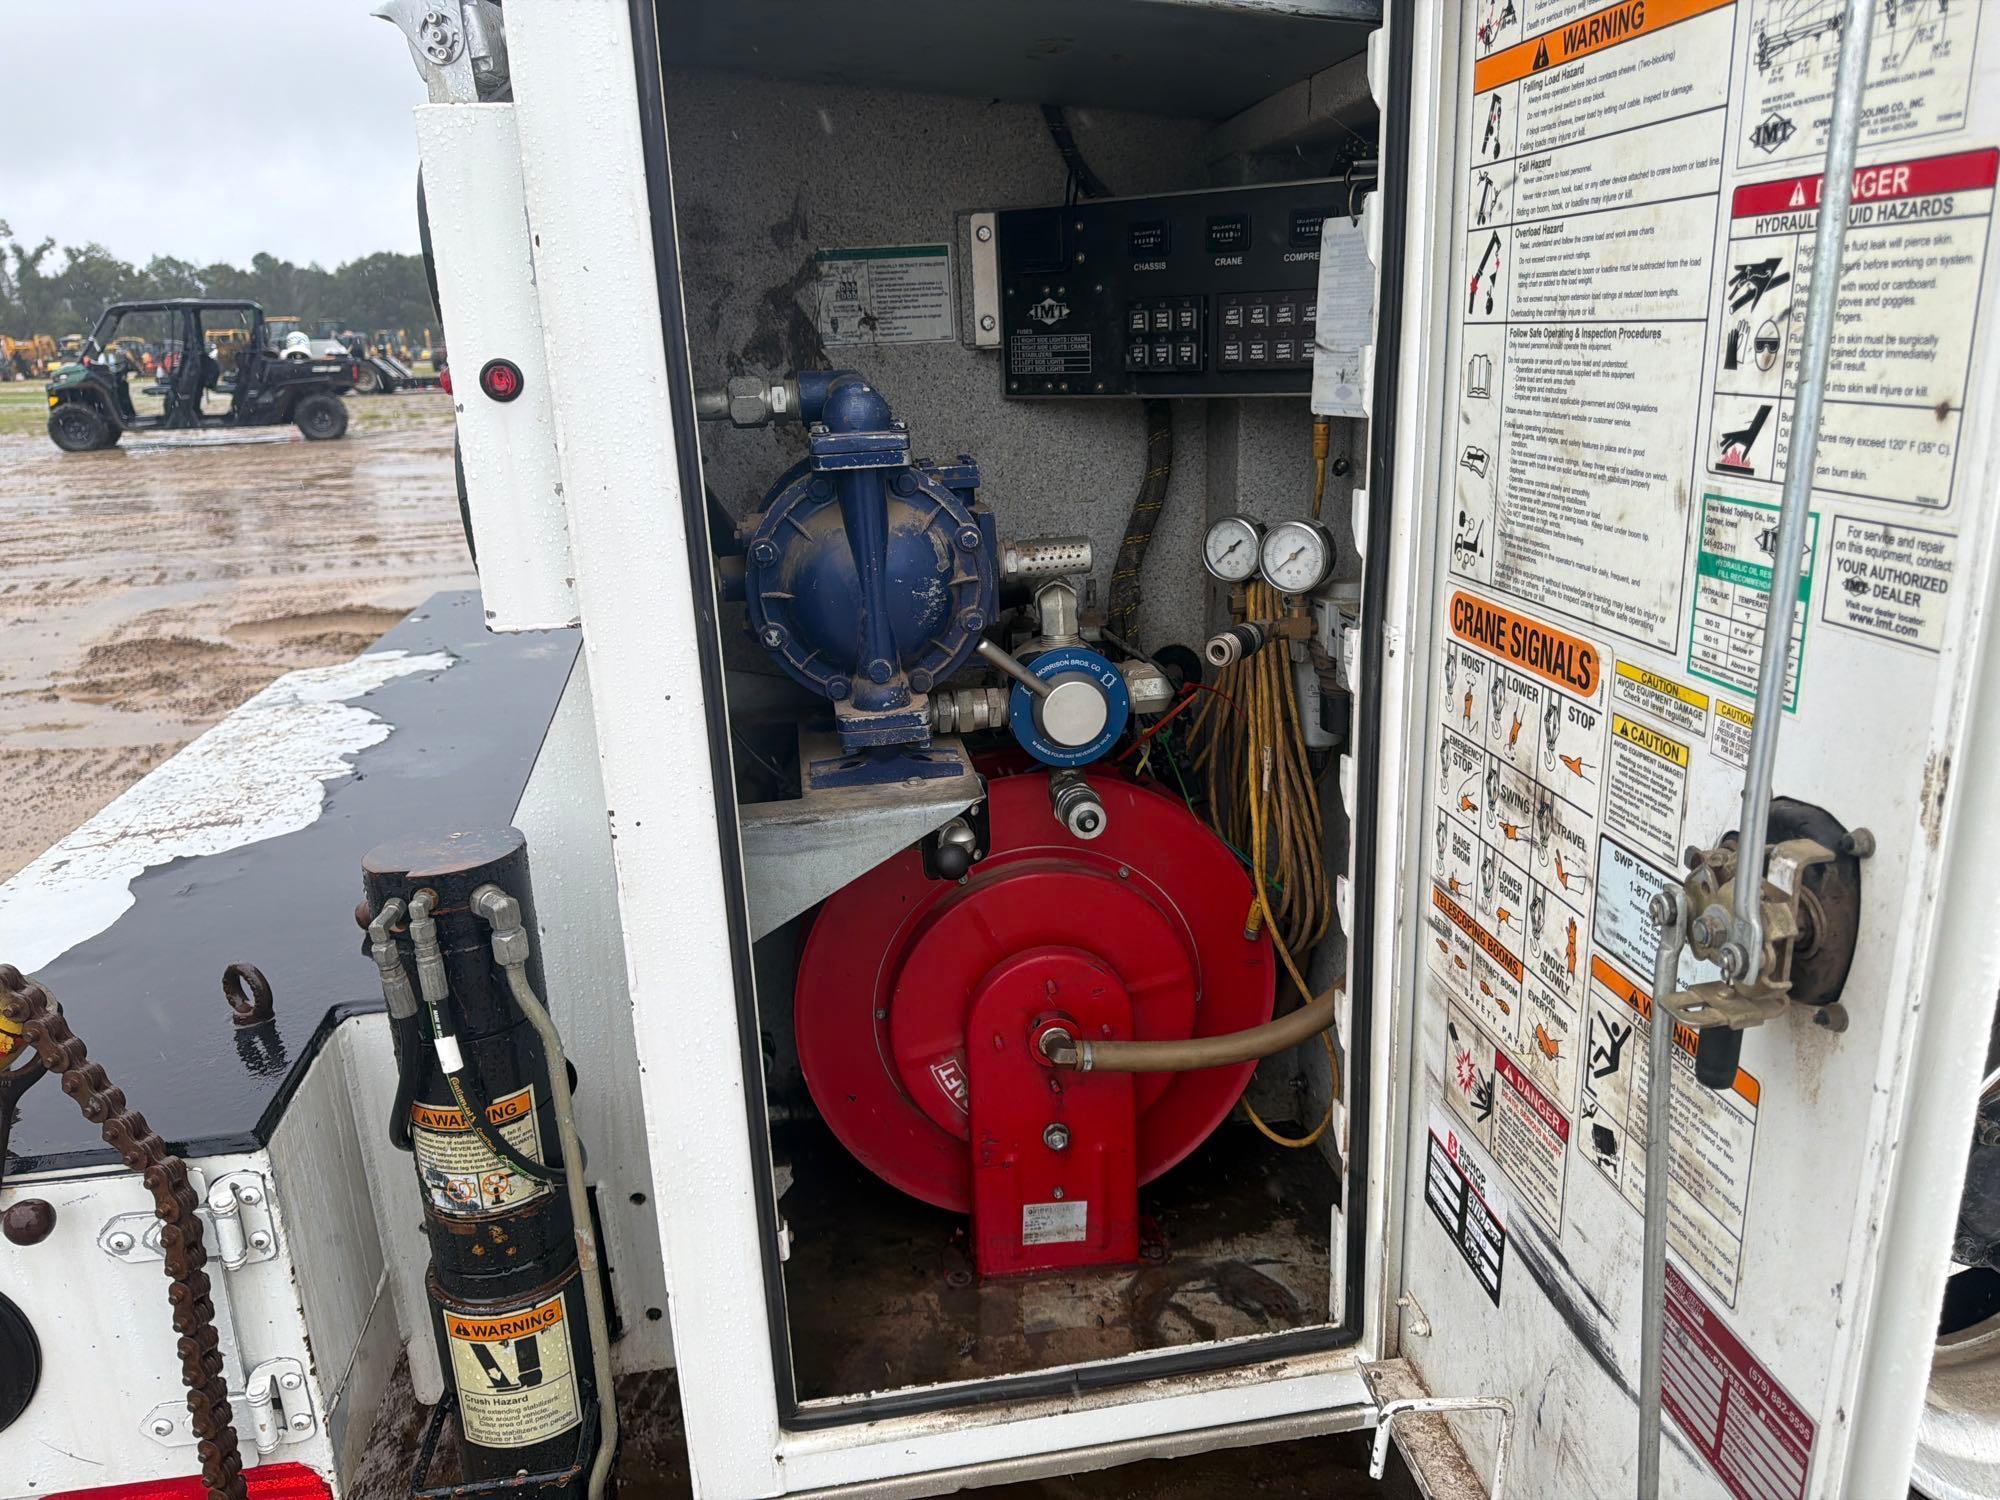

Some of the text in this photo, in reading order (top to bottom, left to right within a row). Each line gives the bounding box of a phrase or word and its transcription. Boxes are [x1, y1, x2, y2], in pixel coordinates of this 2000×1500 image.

[1563, 1, 1644, 55] WARNING
[1523, 63, 1584, 94] Falling Load Hazard
[1754, 119, 1791, 147] IMT
[1519, 156, 1551, 172] Fall Hazard
[1851, 206, 1873, 224] UID
[1878, 196, 1954, 221] HAZARDS
[1515, 224, 1563, 238] Overload Hazard
[1852, 241, 1868, 250] fluid
[1870, 240, 1887, 250] leak
[1888, 238, 1902, 247] will
[1905, 236, 1930, 249] pierce
[1134, 262, 1166, 271] CHASSIS
[1215, 257, 1243, 266] CRANE
[1863, 253, 1973, 270] before working on system.
[1841, 278, 1937, 292] with wood or cardboard.
[1032, 303, 1065, 319] IMT
[1838, 296, 1916, 308] gloves and goggles.
[1510, 328, 1661, 340] Follow Safe Operating & Inspection Procedures
[1847, 335, 1861, 344] skin
[1864, 335, 1883, 344] must
[1886, 335, 1896, 344] be
[1898, 335, 1938, 347] surgically
[1839, 436, 1854, 447] may
[1857, 437, 1886, 448] exceed
[1909, 441, 1915, 451] F
[1707, 503, 1718, 513] Iowa
[1720, 506, 1732, 516] Mold
[1734, 508, 1750, 521] Tooling
[1766, 513, 1776, 524] Inc.
[1724, 519, 1737, 529] Iowa
[1705, 527, 1715, 536] USA
[1848, 526, 1944, 554] For service and repair
[1836, 540, 1847, 550] on
[1848, 541, 1862, 553] this
[1864, 546, 1914, 565] equipment,
[1837, 558, 1947, 593] YOUR AUTHORIZED
[1701, 586, 1729, 600] HYDRAULIC
[1845, 580, 1921, 607] IMT DEALER
[1846, 600, 1859, 611] Visit
[1861, 605, 1873, 614] our
[1875, 607, 1895, 620] dealer
[1850, 613, 1918, 637] www.imt.com
[1454, 598, 1591, 690] CRANE SIGNALS
[1036, 660, 1069, 678] MORRISON
[1071, 659, 1089, 667] BROS.
[1462, 653, 1485, 675] HOIST
[1507, 673, 1539, 703] LOWER
[1641, 674, 1678, 696] CAUTION
[1617, 679, 1703, 720] AVOID EQUIPMENT DAMAGE
[1623, 690, 1640, 704] Check
[1650, 702, 1663, 715] level
[1666, 708, 1693, 729] regularly.
[1568, 706, 1595, 730] STOP
[1450, 735, 1483, 764] EMERGENCY
[1614, 740, 1628, 752] AVOID
[1628, 746, 1656, 766] EQUIPMENT
[1631, 727, 1679, 761] CAUTION
[1453, 753, 1473, 773] STOP
[1501, 784, 1529, 814] SWING
[1453, 832, 1471, 853] RAISE
[1557, 823, 1587, 851] TRAVEL
[1452, 845, 1470, 866] BOOM
[1498, 868, 1522, 894] LOWER
[1614, 850, 1664, 890] SWP Techni
[1499, 882, 1520, 906] BOOM
[1436, 891, 1519, 974] TELESCOPING BOOMS
[1455, 934, 1470, 952] BOOM
[1543, 951, 1565, 974] MOVE
[1475, 954, 1518, 998] RETRACT BOOM
[1540, 967, 1570, 995] SLOWLY
[1528, 989, 1568, 1033] EVERYTHING
[1541, 990, 1556, 1009] DOG
[1518, 1076, 1559, 1130] DANGER
[1460, 1145, 1486, 1185] BISHOP
[1458, 1157, 1485, 1199] LIFTING
[472, 1309, 555, 1337] WARNING
[1749, 1366, 1769, 1396] (575)
[465, 1395, 528, 1406] Crush Hazard
[467, 1405, 485, 1414] Before
[487, 1406, 521, 1415] extending
[471, 1427, 500, 1436] Extending
[502, 1425, 538, 1436] stabilizers
[550, 1410, 572, 1427] people
[535, 1409, 560, 1423] people.
